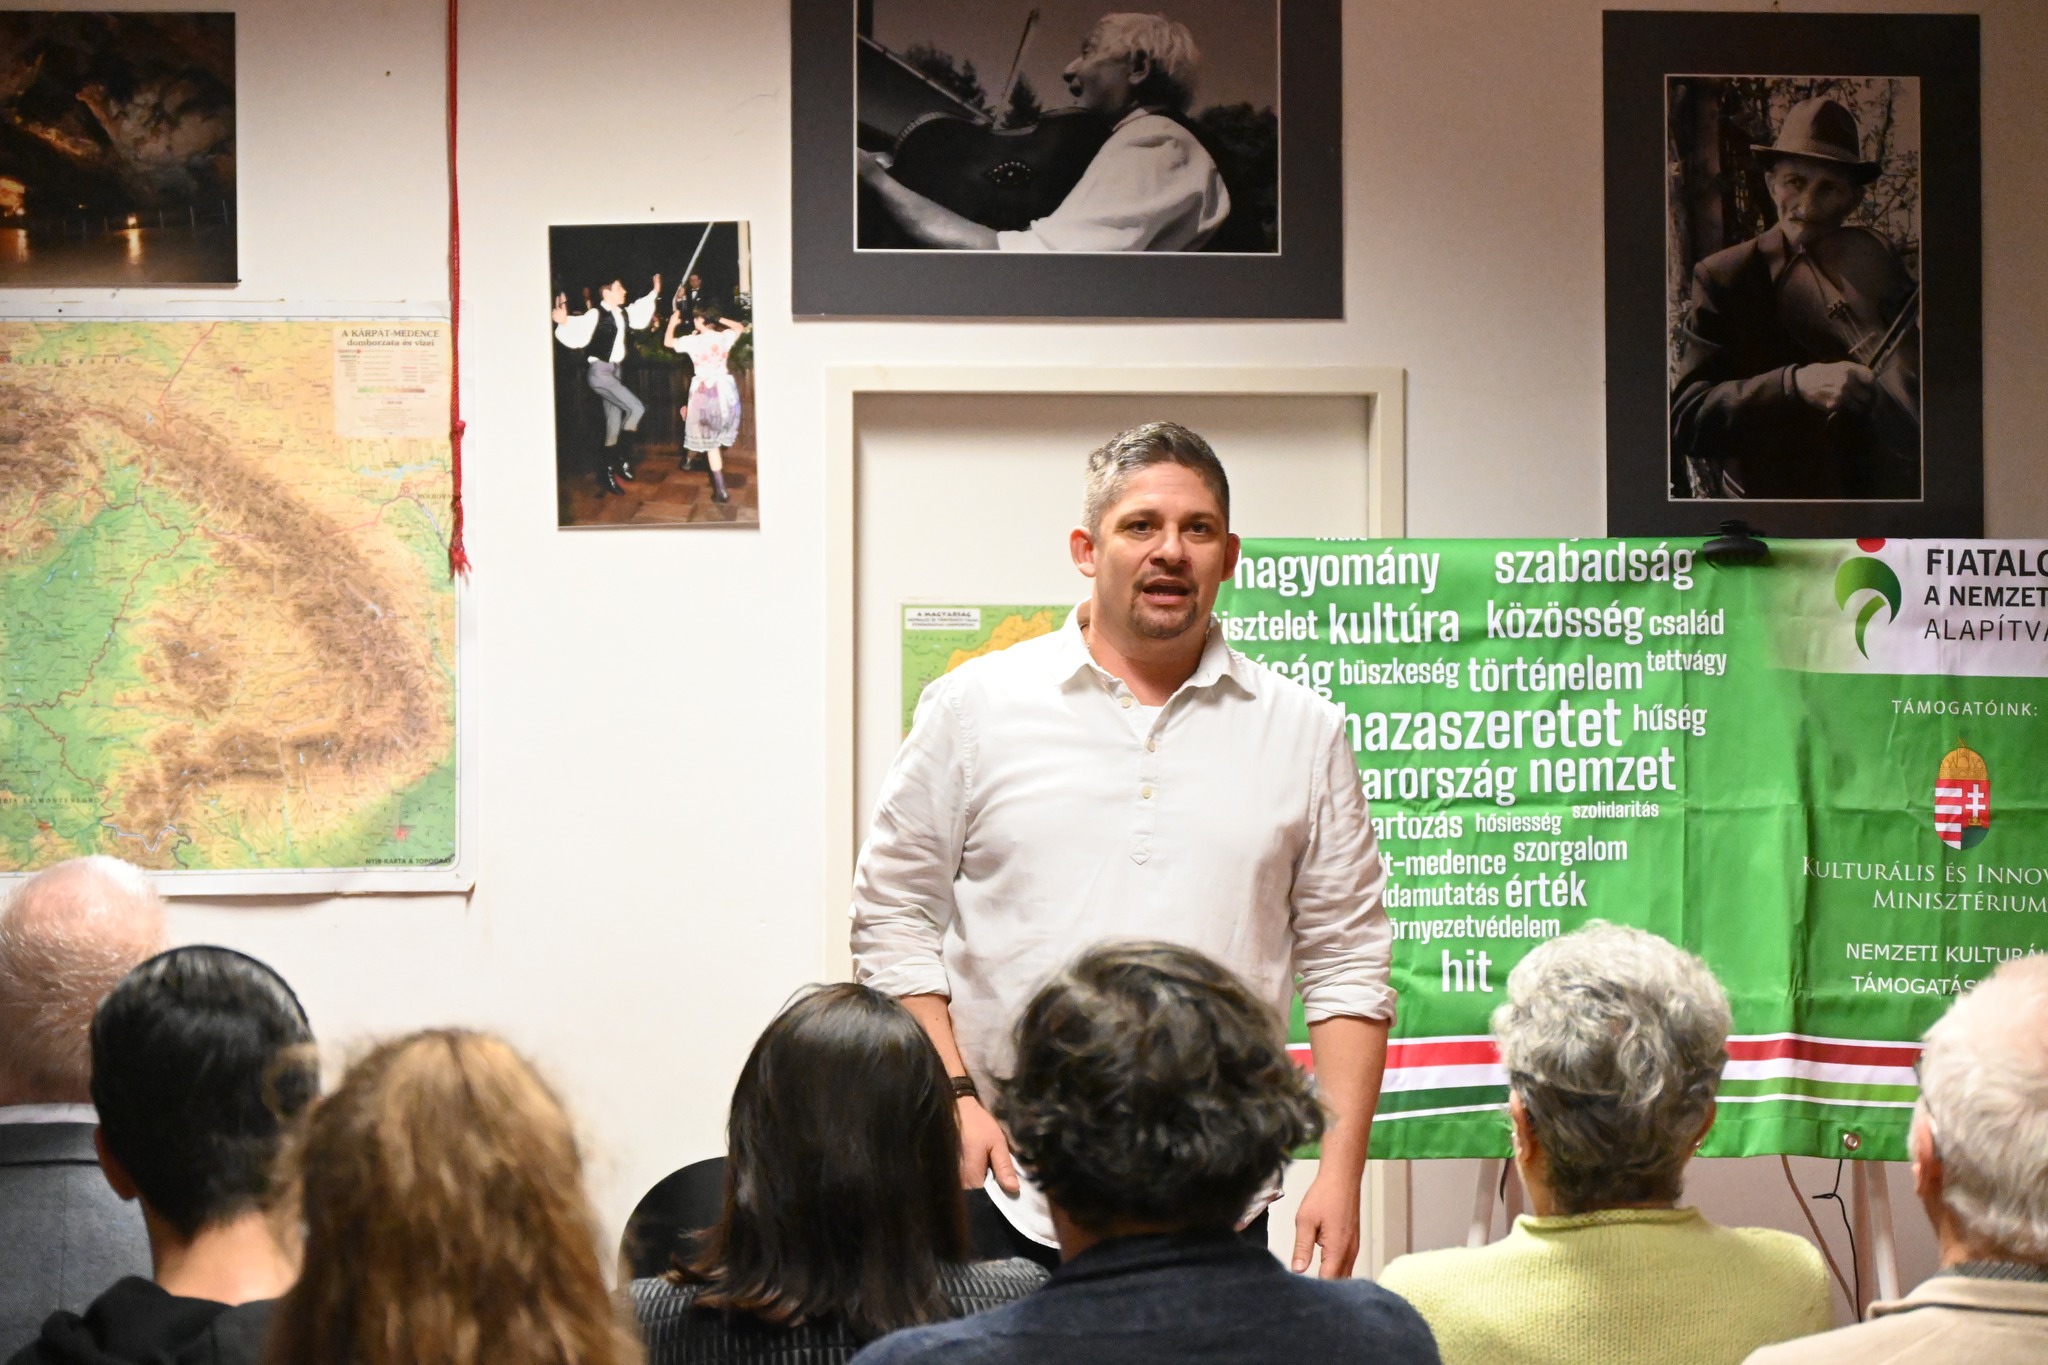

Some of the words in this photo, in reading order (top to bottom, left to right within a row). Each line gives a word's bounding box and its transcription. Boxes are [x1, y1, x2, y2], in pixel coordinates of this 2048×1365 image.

[1234, 546, 1440, 598] hagyomány
[1494, 541, 1696, 591] szabadság
[1924, 585, 1940, 606] A
[1215, 609, 1319, 642] isztelet
[1328, 601, 1459, 645] kultúra
[1487, 599, 1645, 646] közösség
[1649, 608, 1724, 636] család
[1339, 657, 1460, 689] büszkeség
[1467, 654, 1643, 693] történelem
[1646, 649, 1728, 676] tettvágy
[1633, 703, 1708, 737] hűség
[1891, 698, 2037, 717] TÁMOGATÓINK:
[1341, 698, 1623, 753] hazaszeretet
[1359, 758, 1518, 807] arország
[1529, 746, 1677, 793] nemzet
[1371, 810, 1464, 841] artozás
[1475, 812, 1563, 836] hősiesség
[1572, 801, 1660, 819] szolidaritás
[1379, 848, 1507, 877] t-medence
[1513, 835, 1628, 867] szorgalom
[1382, 881, 1500, 909] ldamutatás
[1505, 871, 1588, 908] érték
[1390, 914, 1561, 945] örnyezetvédelem
[1846, 943, 1938, 962] NEMZETI
[1440, 949, 1495, 994] hit
